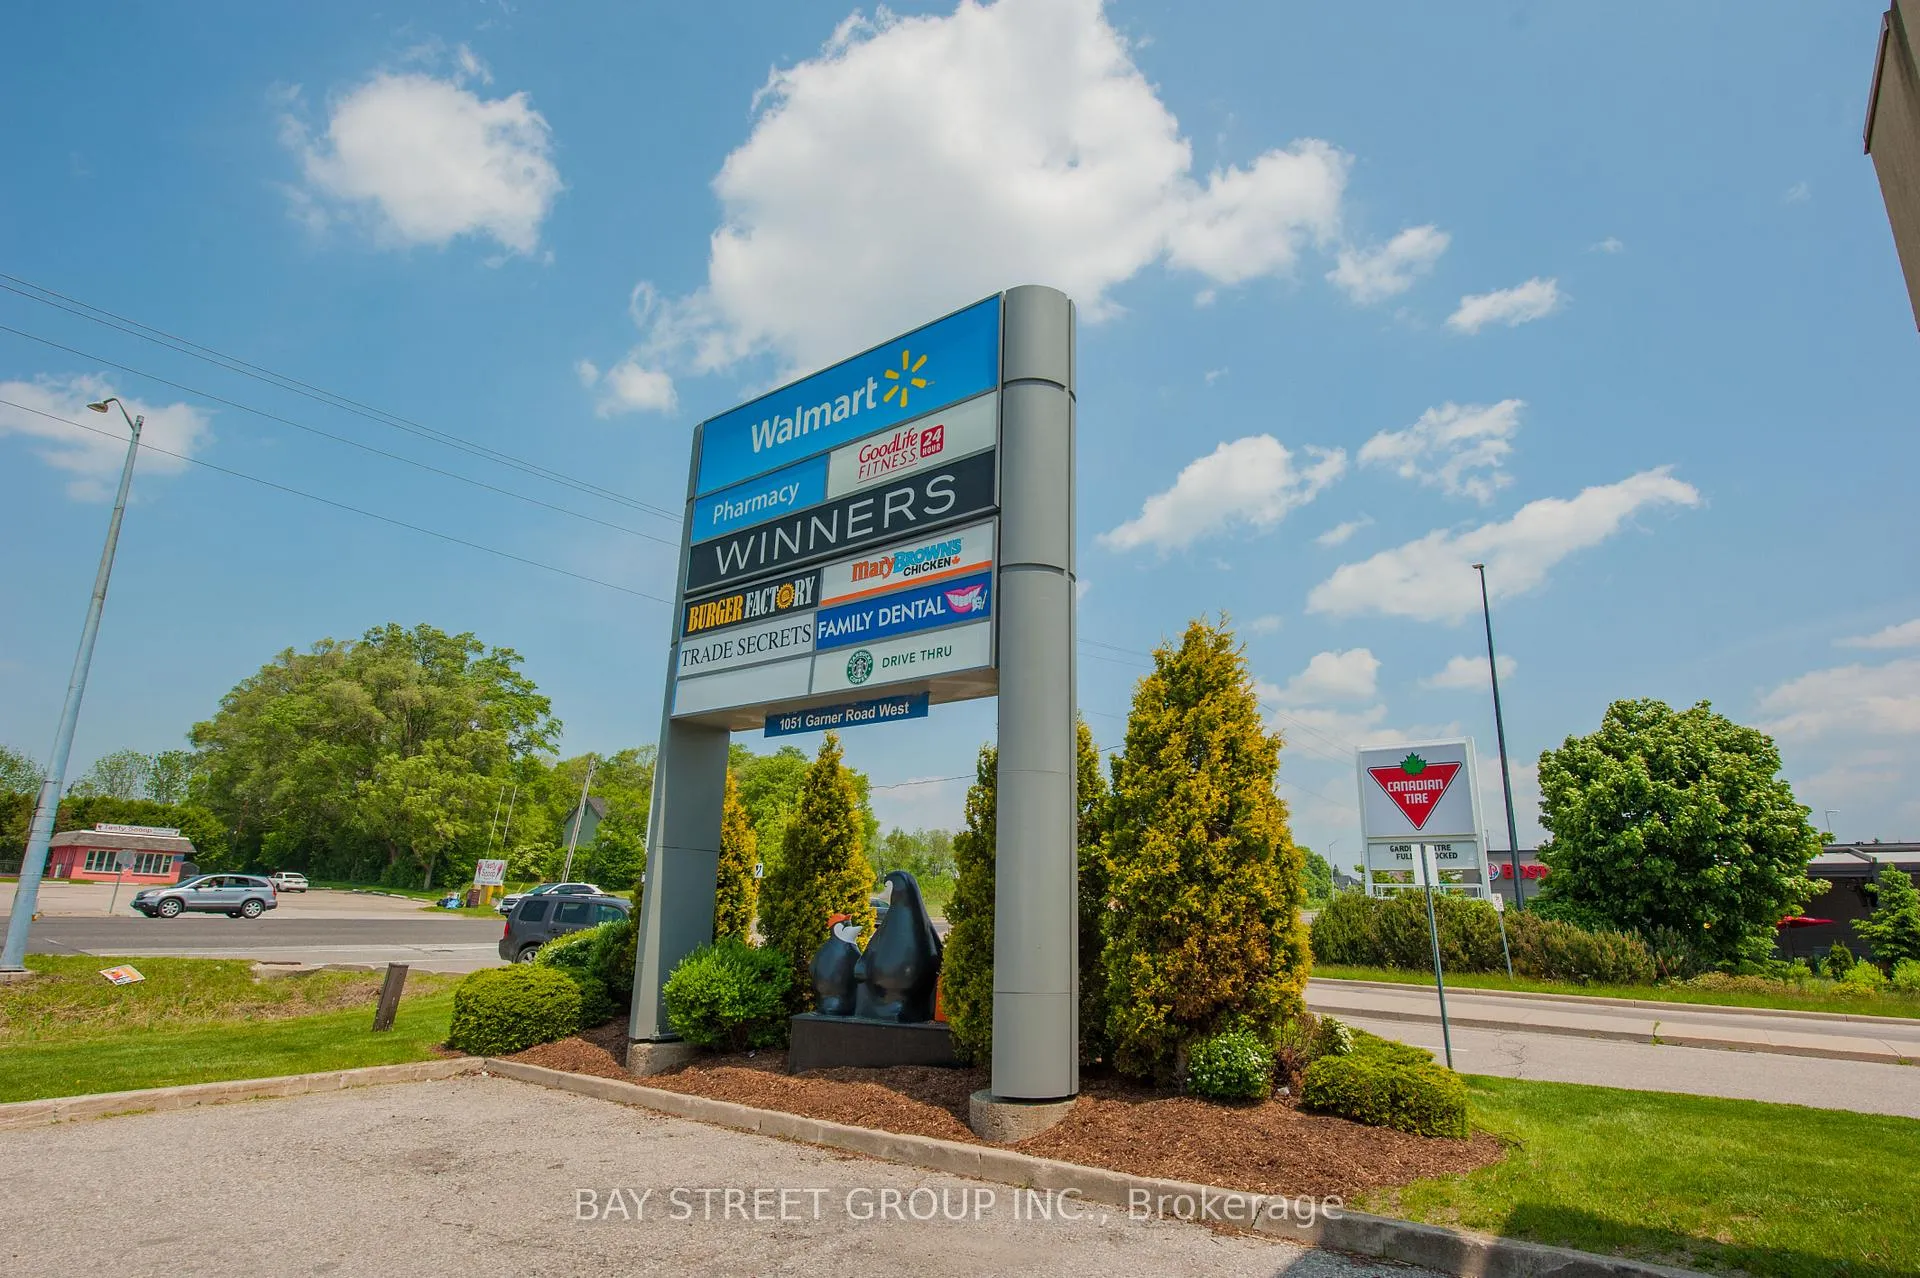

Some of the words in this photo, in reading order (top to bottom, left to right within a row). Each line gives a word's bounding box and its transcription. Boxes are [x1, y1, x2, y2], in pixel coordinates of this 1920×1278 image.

[751, 376, 878, 453] Walmart
[859, 427, 918, 463] GoodLife
[922, 427, 942, 447] 24
[922, 442, 941, 456] HOUR
[858, 447, 917, 479] FITNESS
[713, 481, 800, 525] Pharmacy
[715, 474, 956, 576] WINNERS
[903, 557, 951, 577] CHICKEN
[687, 594, 744, 632] BURGER
[817, 610, 874, 639] FAMILY
[878, 595, 946, 627] DENTAL
[681, 640, 733, 667] TRADE
[737, 623, 811, 656] SECRETS
[882, 651, 916, 668] DRIVE
[920, 645, 952, 661] THRU
[779, 716, 801, 731] 1051
[805, 712, 843, 727] Garner
[845, 705, 876, 721] Road
[879, 701, 910, 717] West
[1387, 778, 1444, 793] CANADIAN
[1404, 792, 1429, 805] TIRE
